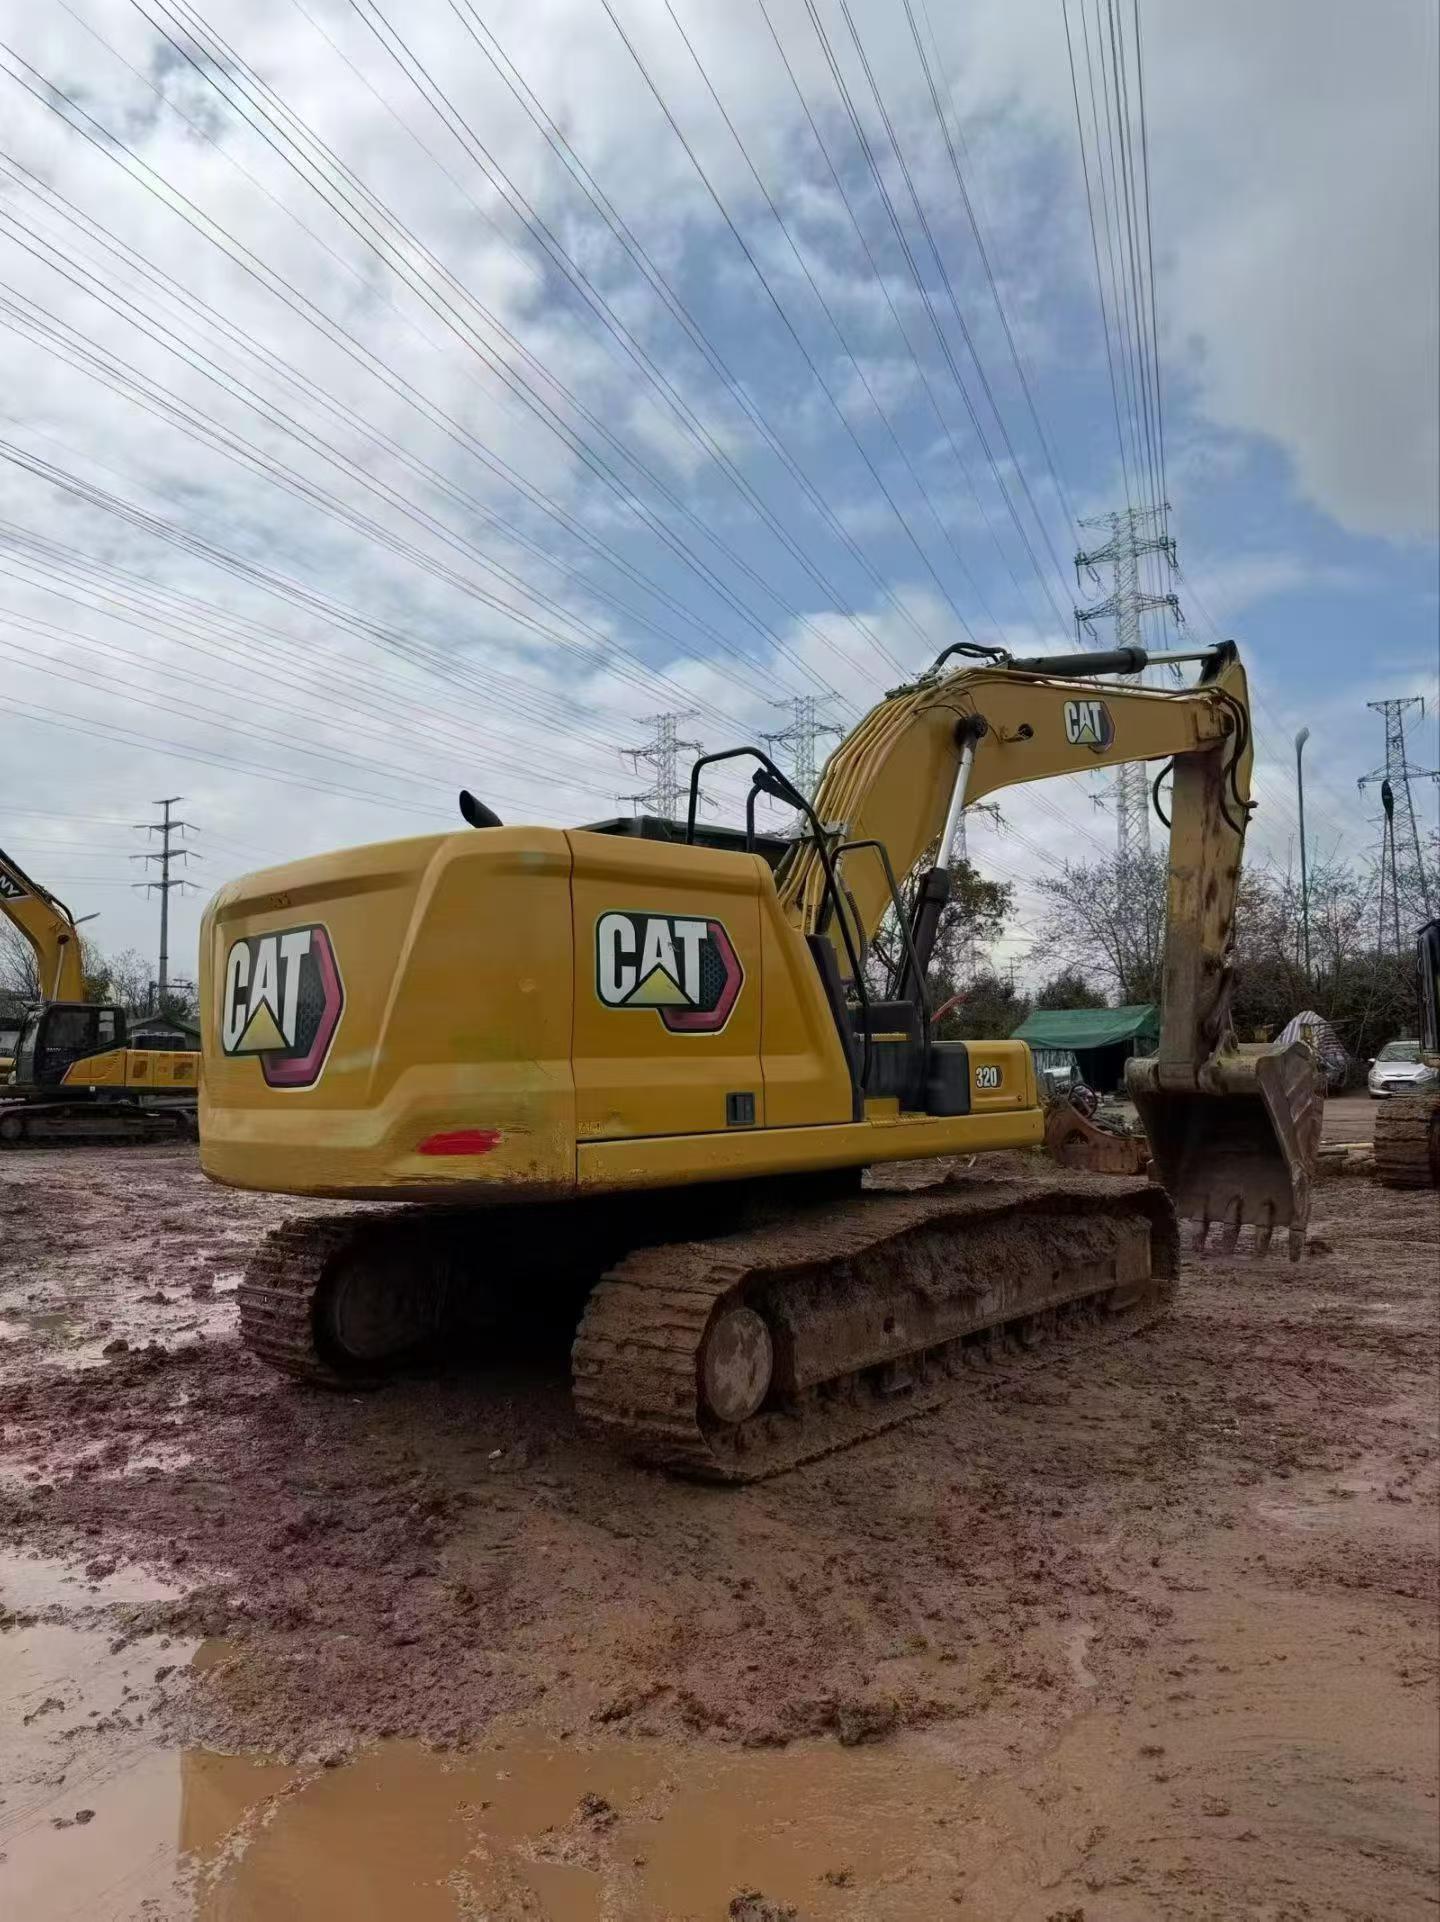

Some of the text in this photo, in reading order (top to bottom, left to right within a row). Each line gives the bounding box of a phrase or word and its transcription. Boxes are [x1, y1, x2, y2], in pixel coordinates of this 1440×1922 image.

[1064, 701, 1102, 743] CAT
[223, 930, 311, 1052] CAT
[599, 914, 708, 1004] CAT
[976, 1067, 997, 1087] 320
